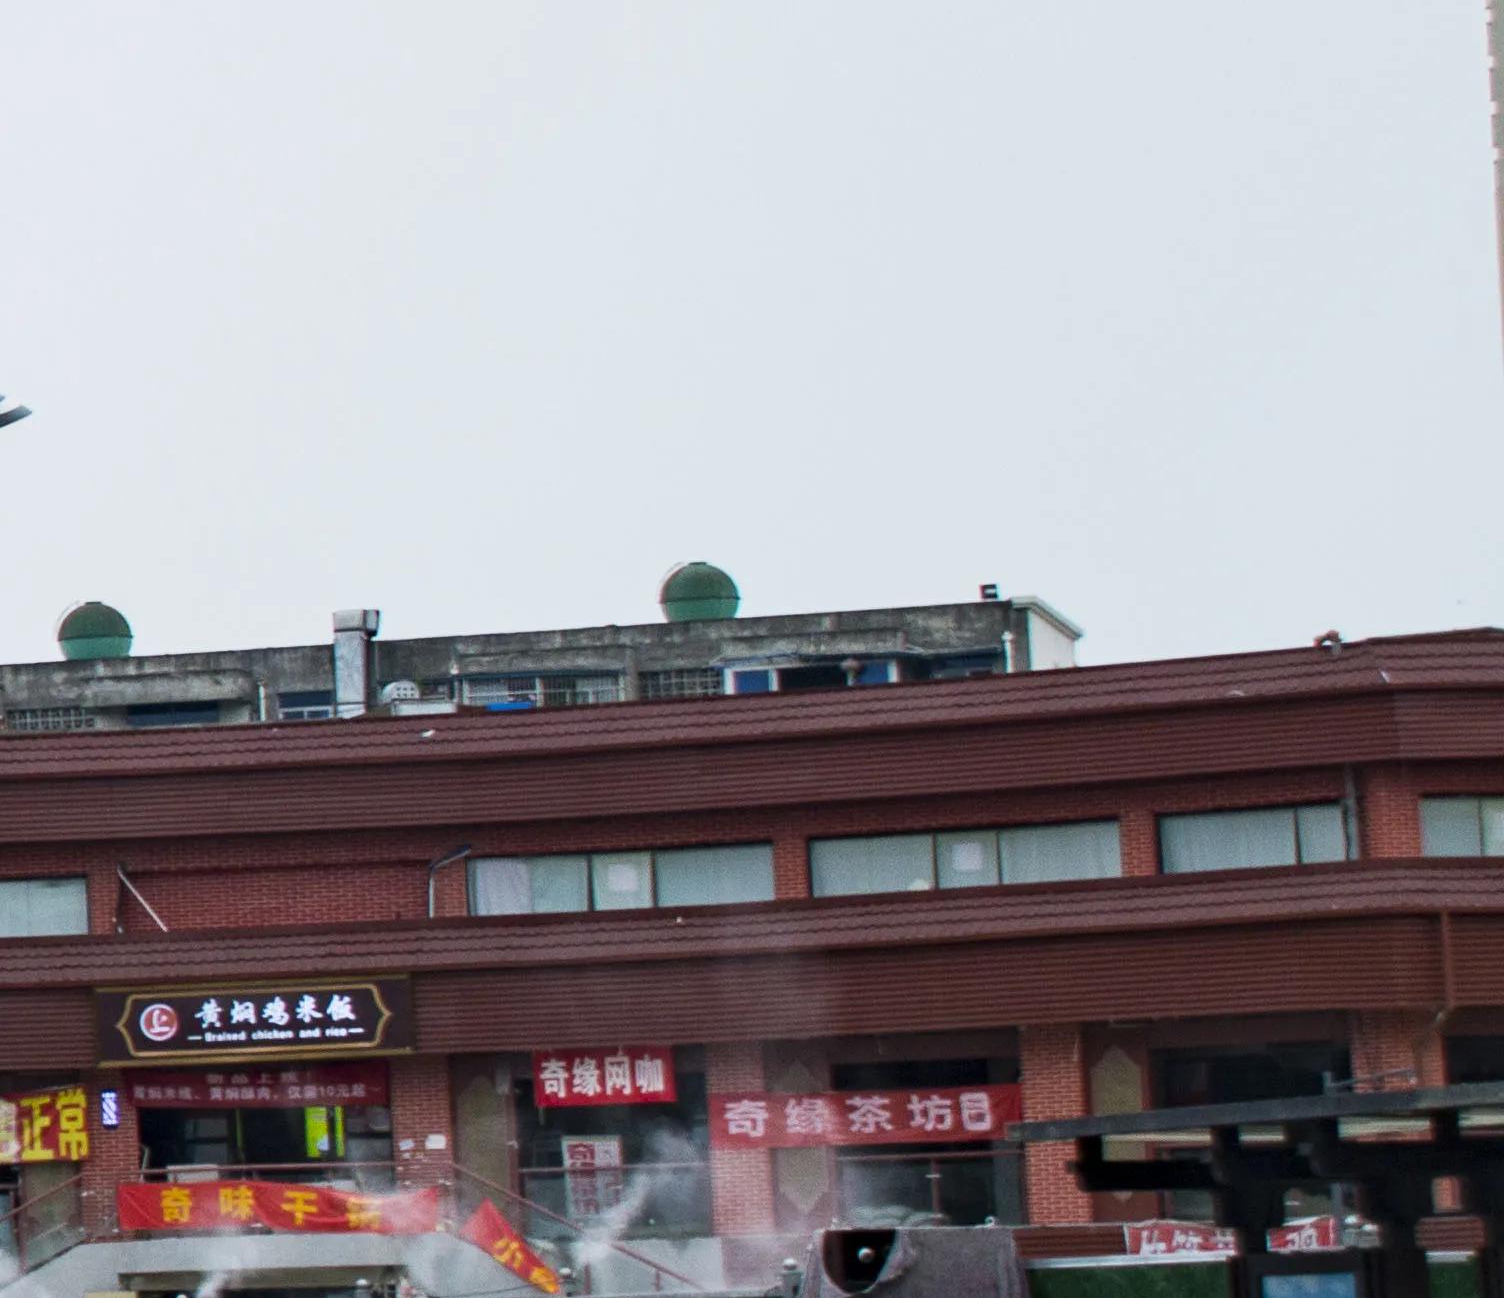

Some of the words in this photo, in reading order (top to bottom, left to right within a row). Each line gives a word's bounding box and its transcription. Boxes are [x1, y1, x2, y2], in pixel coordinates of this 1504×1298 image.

[194, 994, 356, 1028] 黄焖鸡米饭
[251, 1029, 294, 1040] chicken
[298, 1027, 320, 1038] and
[325, 1026, 348, 1037] rice
[540, 1055, 665, 1098] 奇缘网咖
